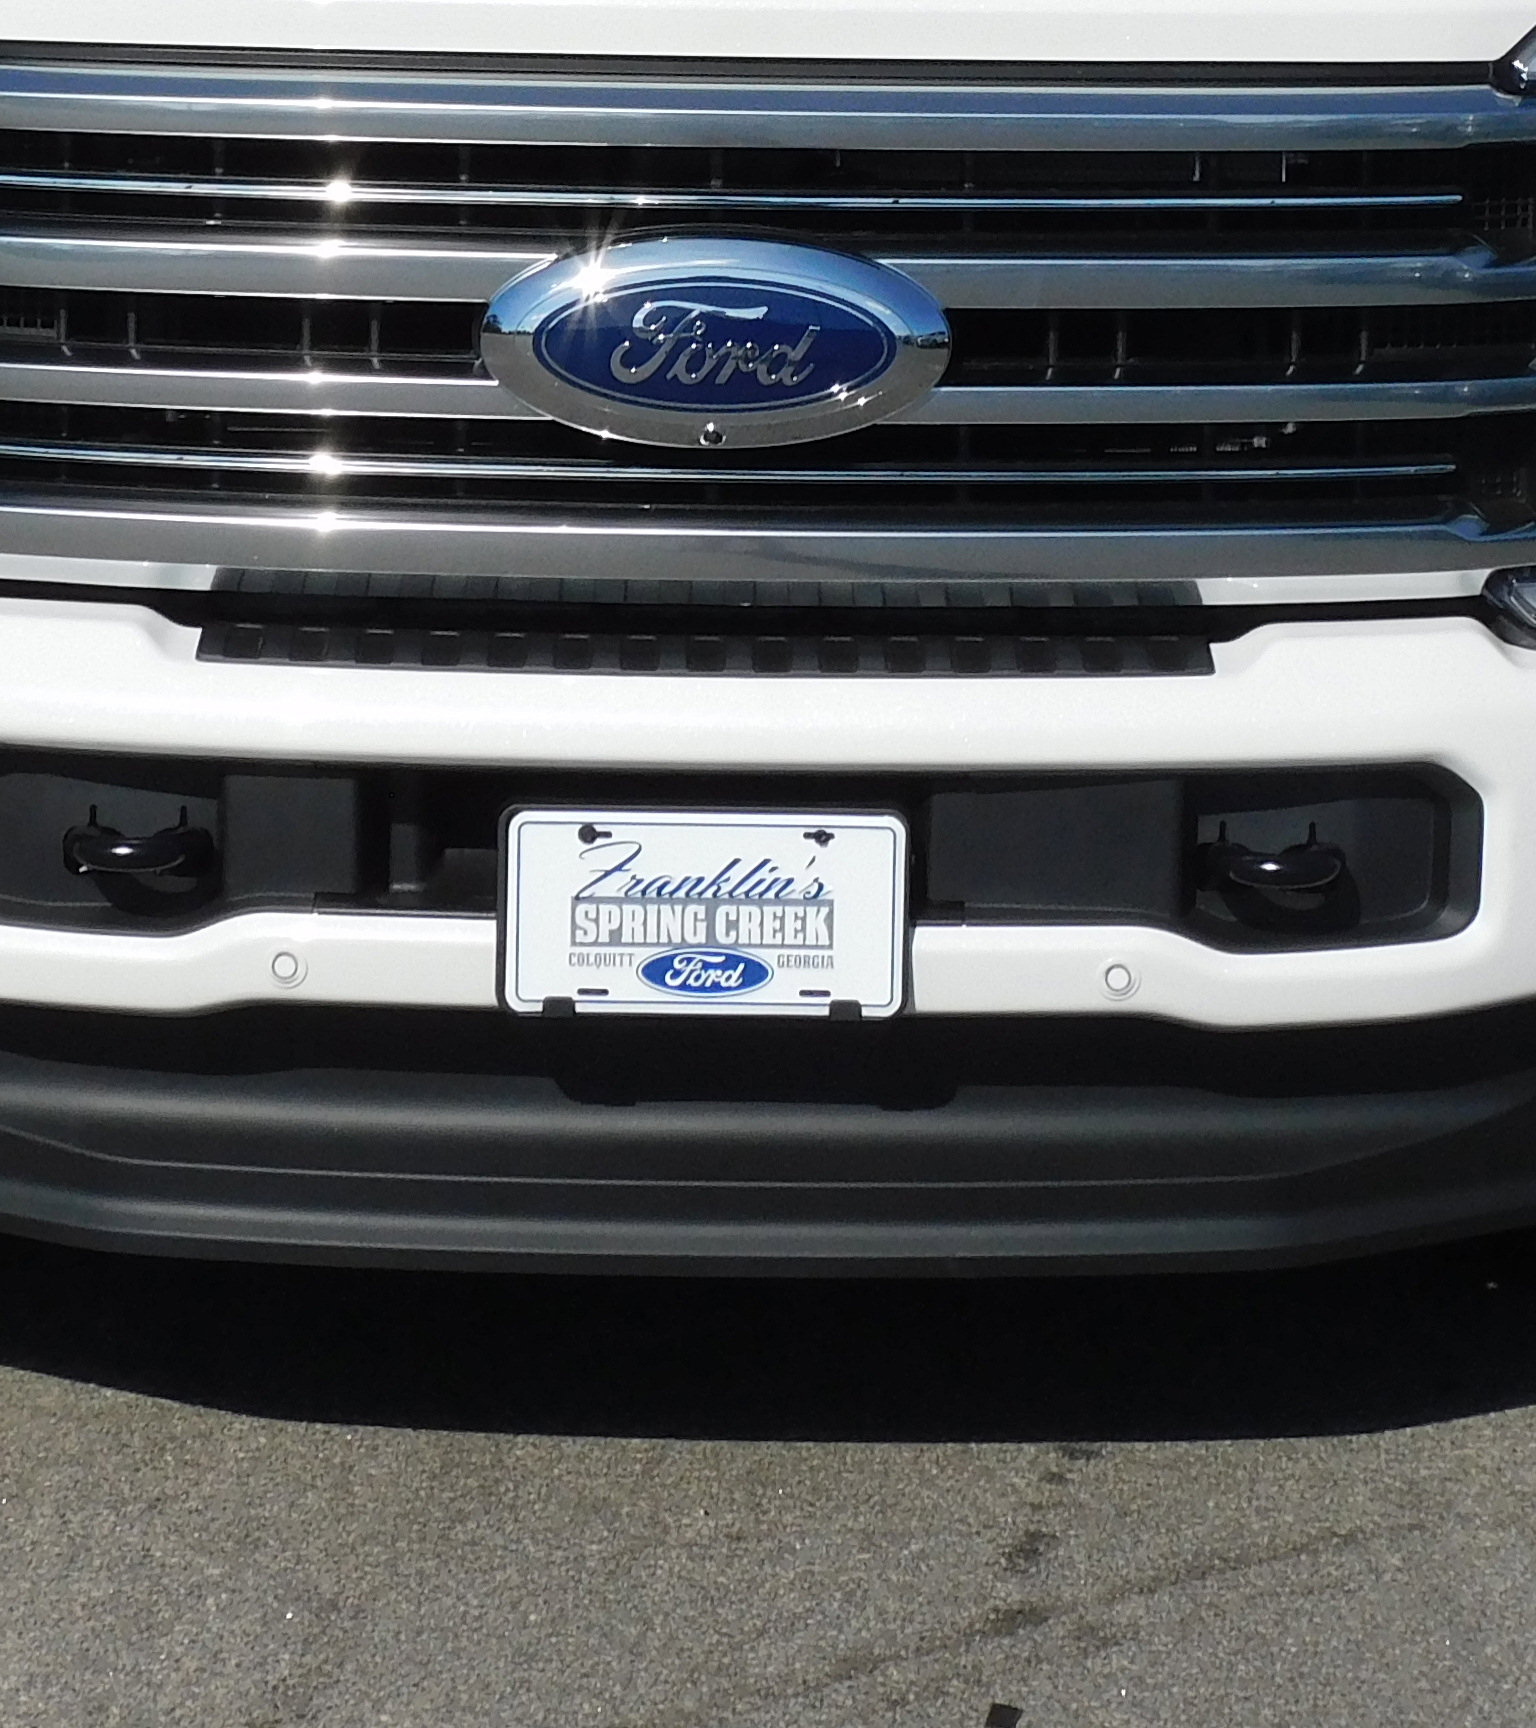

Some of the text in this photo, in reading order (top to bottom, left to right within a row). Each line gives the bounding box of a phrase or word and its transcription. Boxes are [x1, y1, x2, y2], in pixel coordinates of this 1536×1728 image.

[610, 299, 820, 386] Ford
[575, 840, 834, 901] Franklin's
[574, 903, 833, 947] SPRING CREEK
[568, 953, 635, 968] COLQUITT
[664, 953, 746, 988] Ford
[777, 954, 834, 969] GEORGIA
